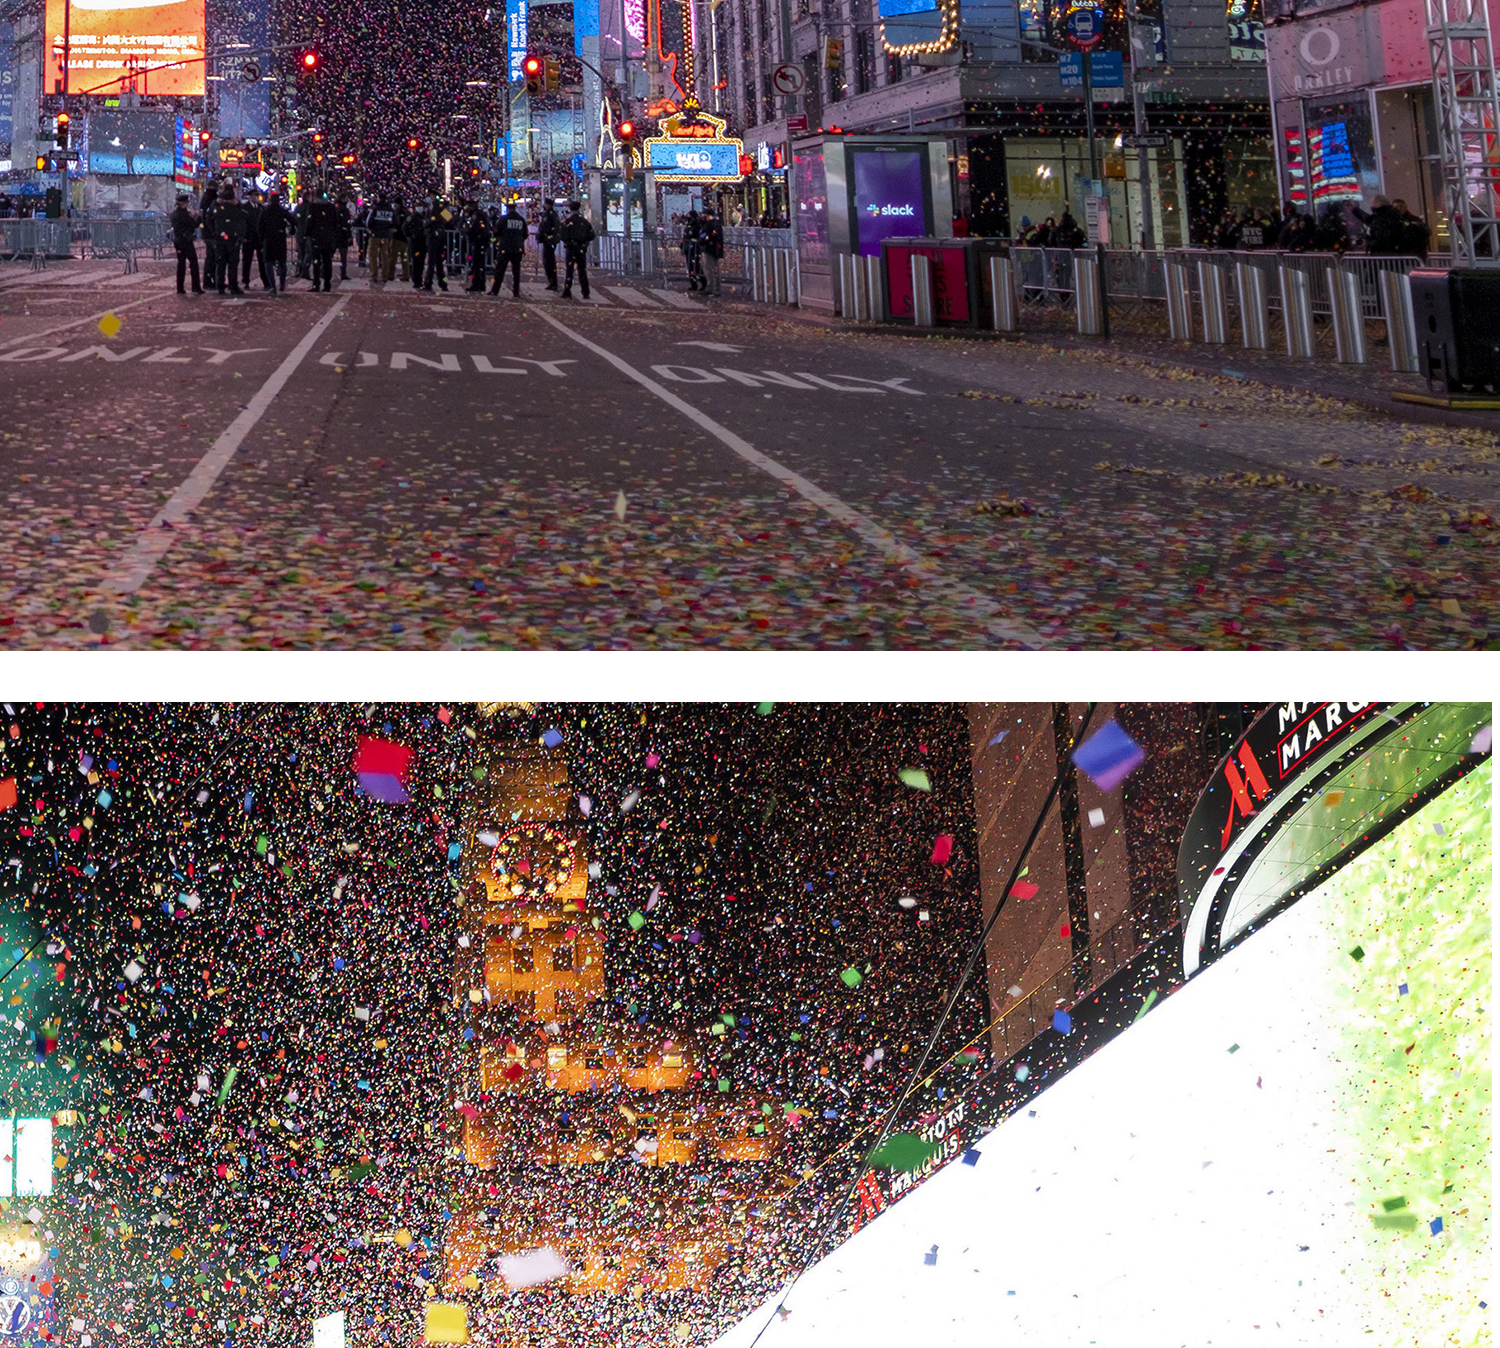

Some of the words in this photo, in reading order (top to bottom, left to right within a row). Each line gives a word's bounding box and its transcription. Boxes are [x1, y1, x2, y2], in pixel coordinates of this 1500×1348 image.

[1060, 64, 1079, 74] M20
[1295, 63, 1353, 93] OAKLEY
[1062, 76, 1083, 86] M104
[881, 204, 915, 216] slack
[318, 351, 578, 378] ONLY
[651, 364, 926, 395] ONLY
